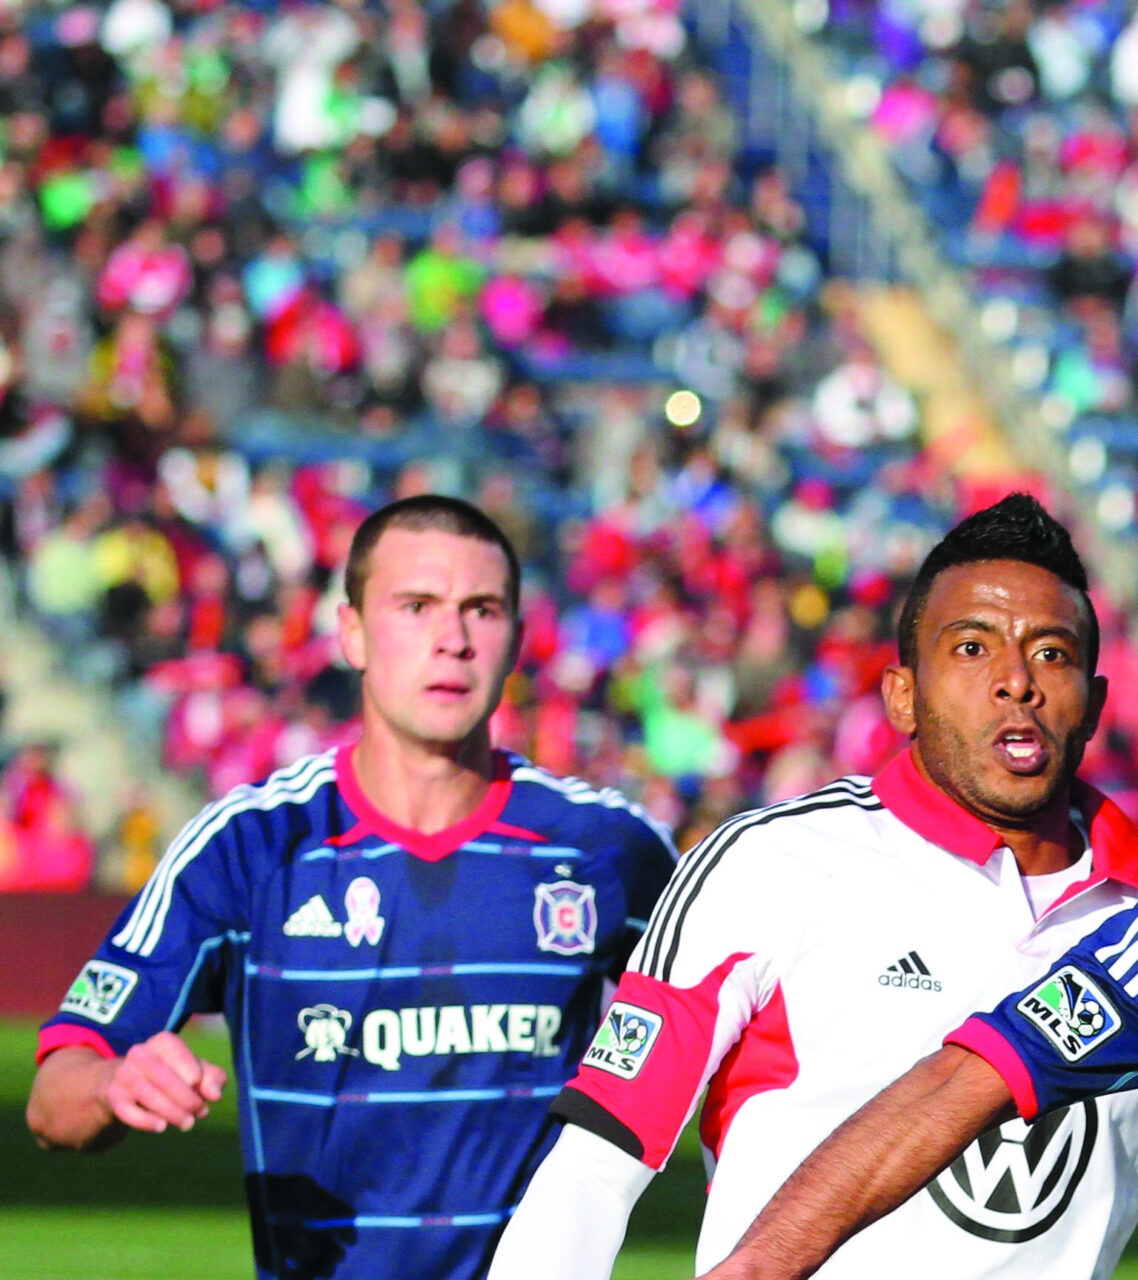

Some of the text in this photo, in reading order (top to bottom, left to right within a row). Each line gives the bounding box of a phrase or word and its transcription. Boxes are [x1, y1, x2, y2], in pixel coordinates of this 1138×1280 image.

[877, 973, 943, 993] adidas
[362, 1003, 562, 1072] QUAKER
[1023, 997, 1082, 1055] MLS
[587, 1046, 636, 1072] MLS
